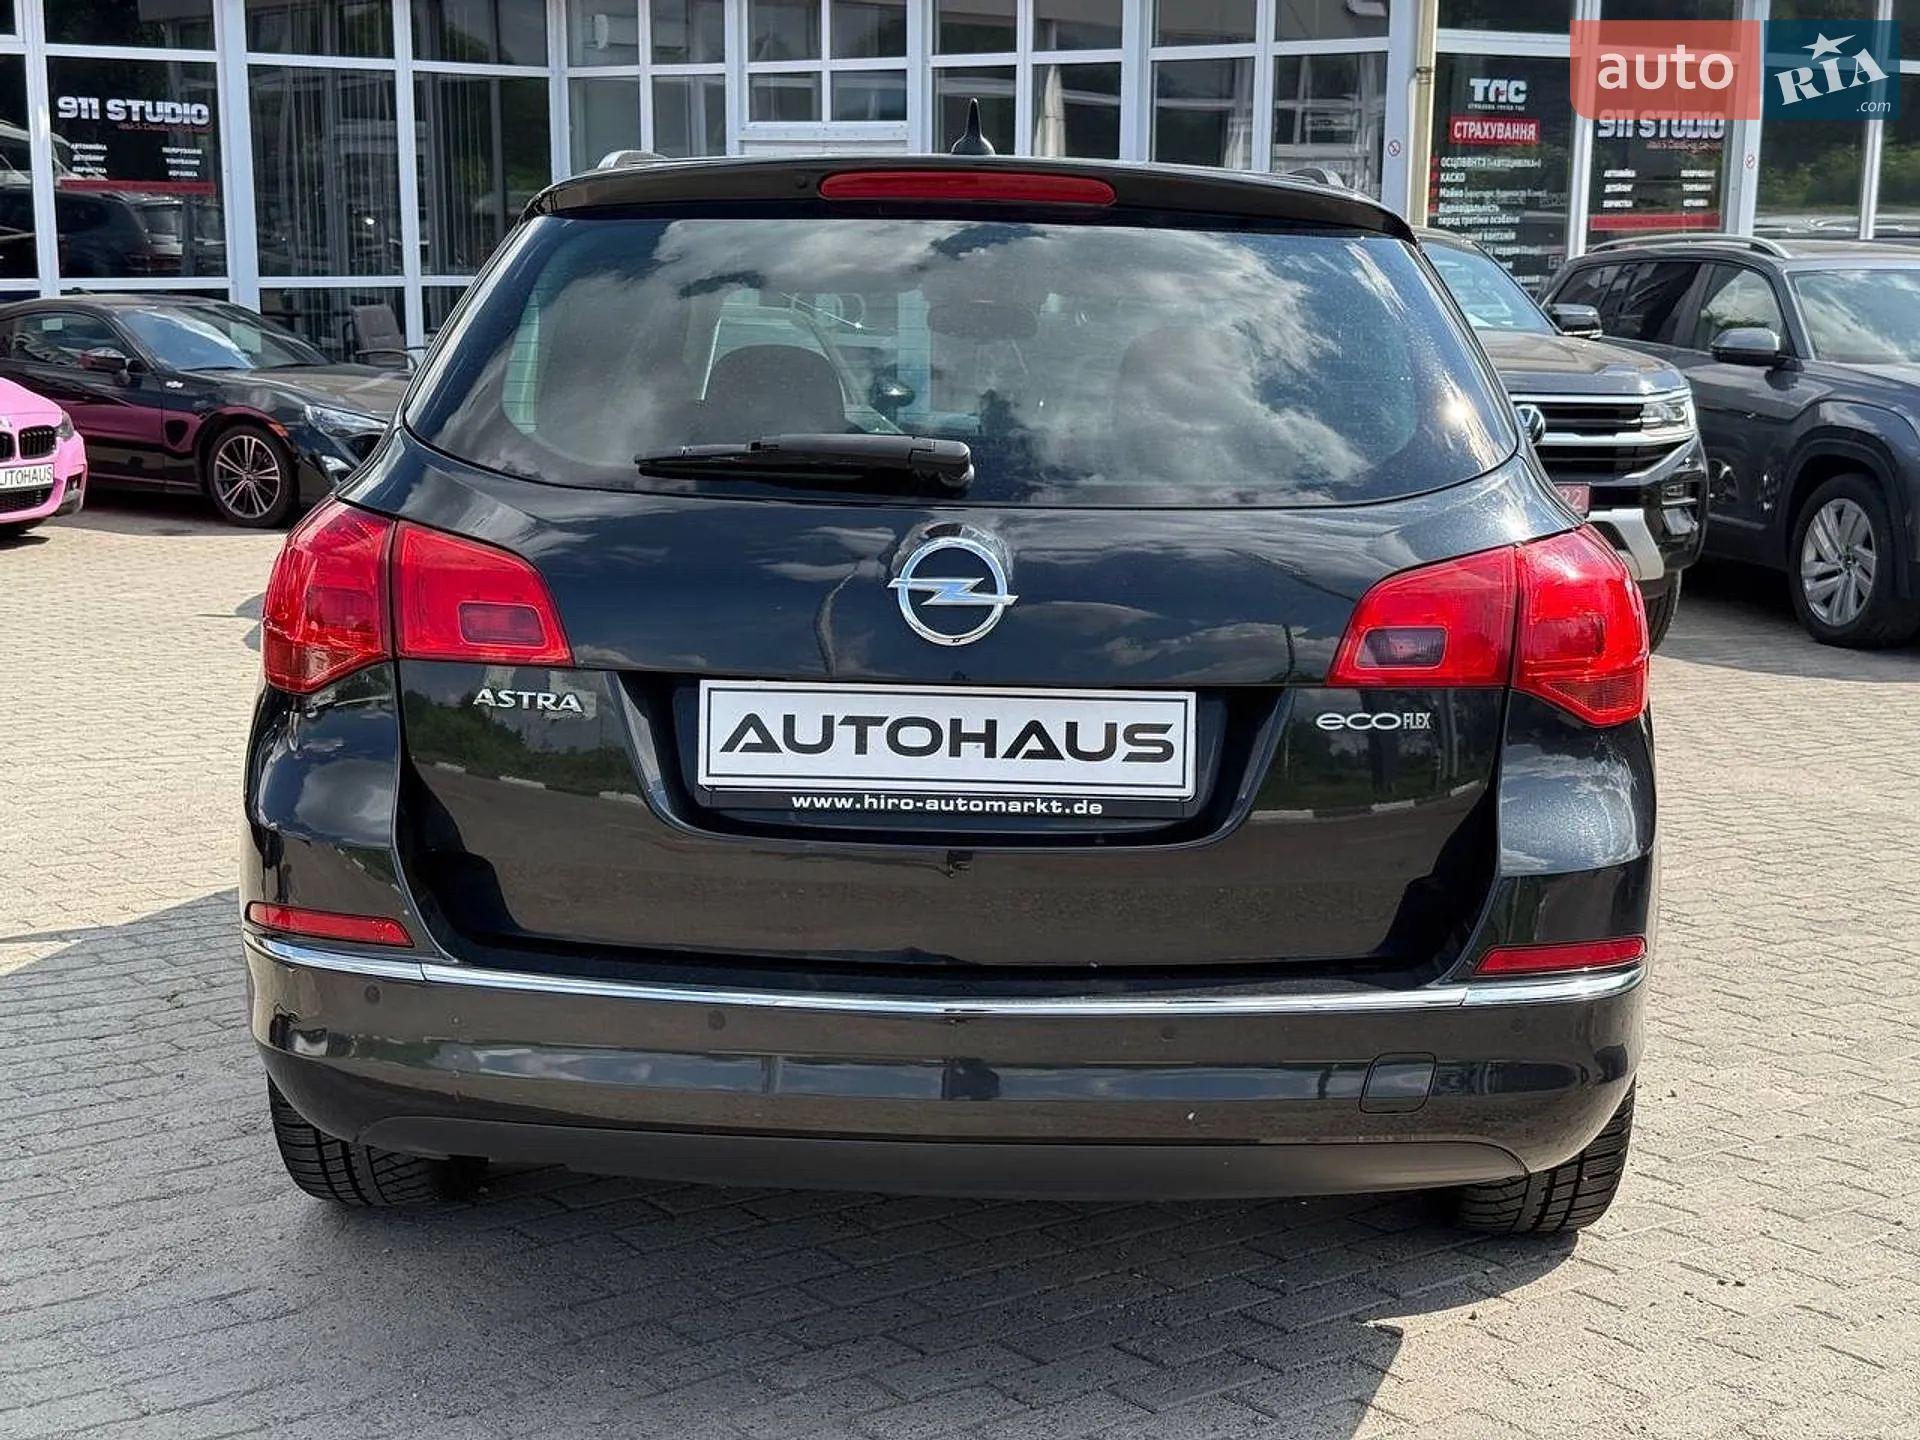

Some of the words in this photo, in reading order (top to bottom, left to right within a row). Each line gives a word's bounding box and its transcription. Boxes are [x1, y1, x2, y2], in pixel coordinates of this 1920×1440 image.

[58, 96, 100, 119] 911
[106, 99, 209, 125] STUDIO
[1453, 121, 1536, 140] СТРАХУВАННЯ
[1597, 109, 1634, 138] 911
[1639, 109, 1725, 139] STUDIO
[473, 688, 583, 712] ASTRA
[719, 712, 1175, 763] AUTOHAUS
[791, 794, 1103, 815] www.hiro-automarkt.de
